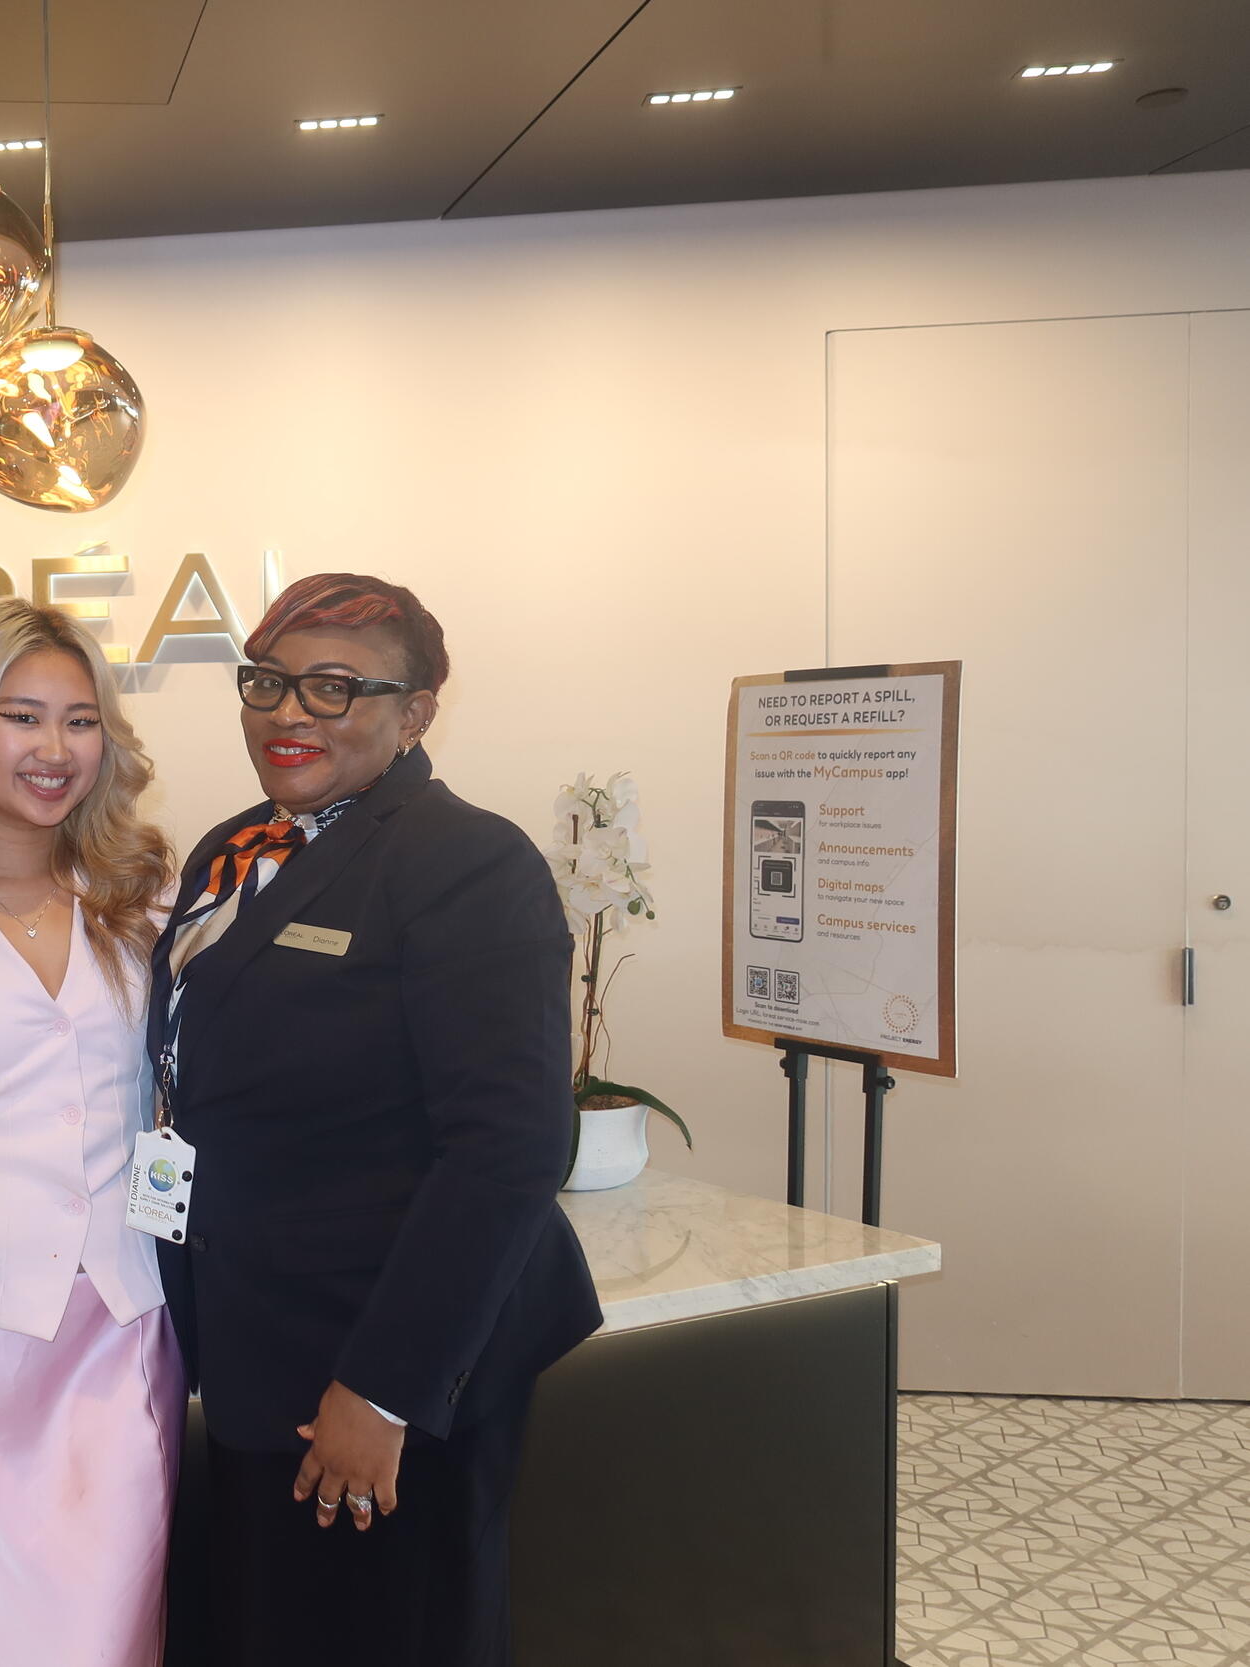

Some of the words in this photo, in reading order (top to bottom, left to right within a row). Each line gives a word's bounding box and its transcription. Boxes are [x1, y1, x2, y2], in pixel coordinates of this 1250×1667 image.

[758, 696, 788, 709] NEED
[790, 695, 806, 707] TO
[809, 692, 860, 706] REPORT
[862, 691, 872, 703] A
[874, 689, 916, 704] SPILL,
[765, 714, 781, 727] OR
[783, 712, 838, 726] REQUEST
[841, 711, 850, 724] A
[853, 710, 906, 723] REFILL?
[750, 751, 770, 761] Scan
[779, 751, 793, 761] QR
[795, 751, 816, 760] code
[817, 751, 828, 760] to
[829, 750, 861, 762] quickly
[863, 750, 895, 761] report
[897, 750, 917, 761] any
[755, 769, 775, 778] issue
[777, 768, 796, 778] with
[797, 768, 812, 778] the
[814, 765, 884, 781] MyCampus
[886, 768, 909, 780] app!
[819, 803, 865, 818] Support
[829, 821, 861, 830] workplace
[862, 821, 882, 830] issues
[819, 841, 915, 857] Announcements
[817, 857, 830, 865] and
[831, 859, 856, 868] campus
[856, 859, 870, 867] info
[817, 878, 852, 892] Digital
[854, 882, 885, 895] maps
[825, 894, 852, 903] navigate
[854, 896, 868, 904] your
[869, 897, 883, 905] new
[885, 898, 905, 907] space
[817, 914, 864, 930] Campus
[867, 920, 917, 934] services
[817, 930, 830, 938] and
[831, 931, 861, 941] resources
[130, 1163, 142, 1201] DIANNE
[150, 1170, 174, 1184] KISS
